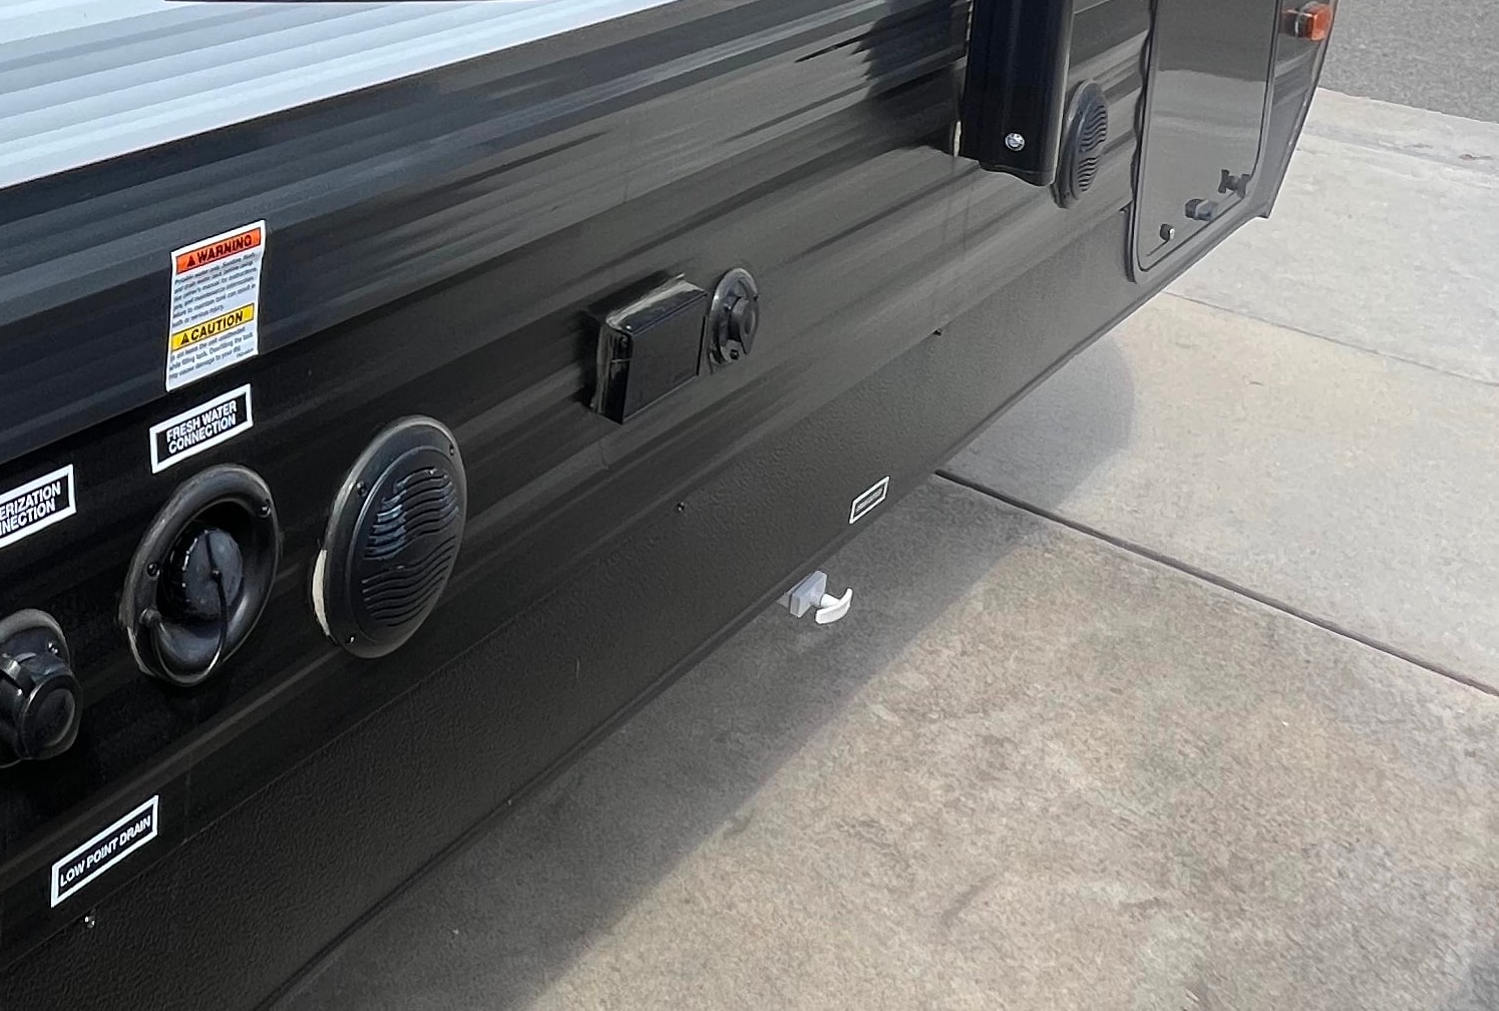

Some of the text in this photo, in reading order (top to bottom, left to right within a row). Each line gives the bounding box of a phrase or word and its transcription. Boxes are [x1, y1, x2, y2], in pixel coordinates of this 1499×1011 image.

[197, 234, 251, 263] WARNING
[191, 310, 242, 340] CAUTION
[166, 400, 237, 443] FRESH WATER
[168, 413, 237, 454] CONNECTION
[60, 815, 151, 887] LOW POINT DRAIN
